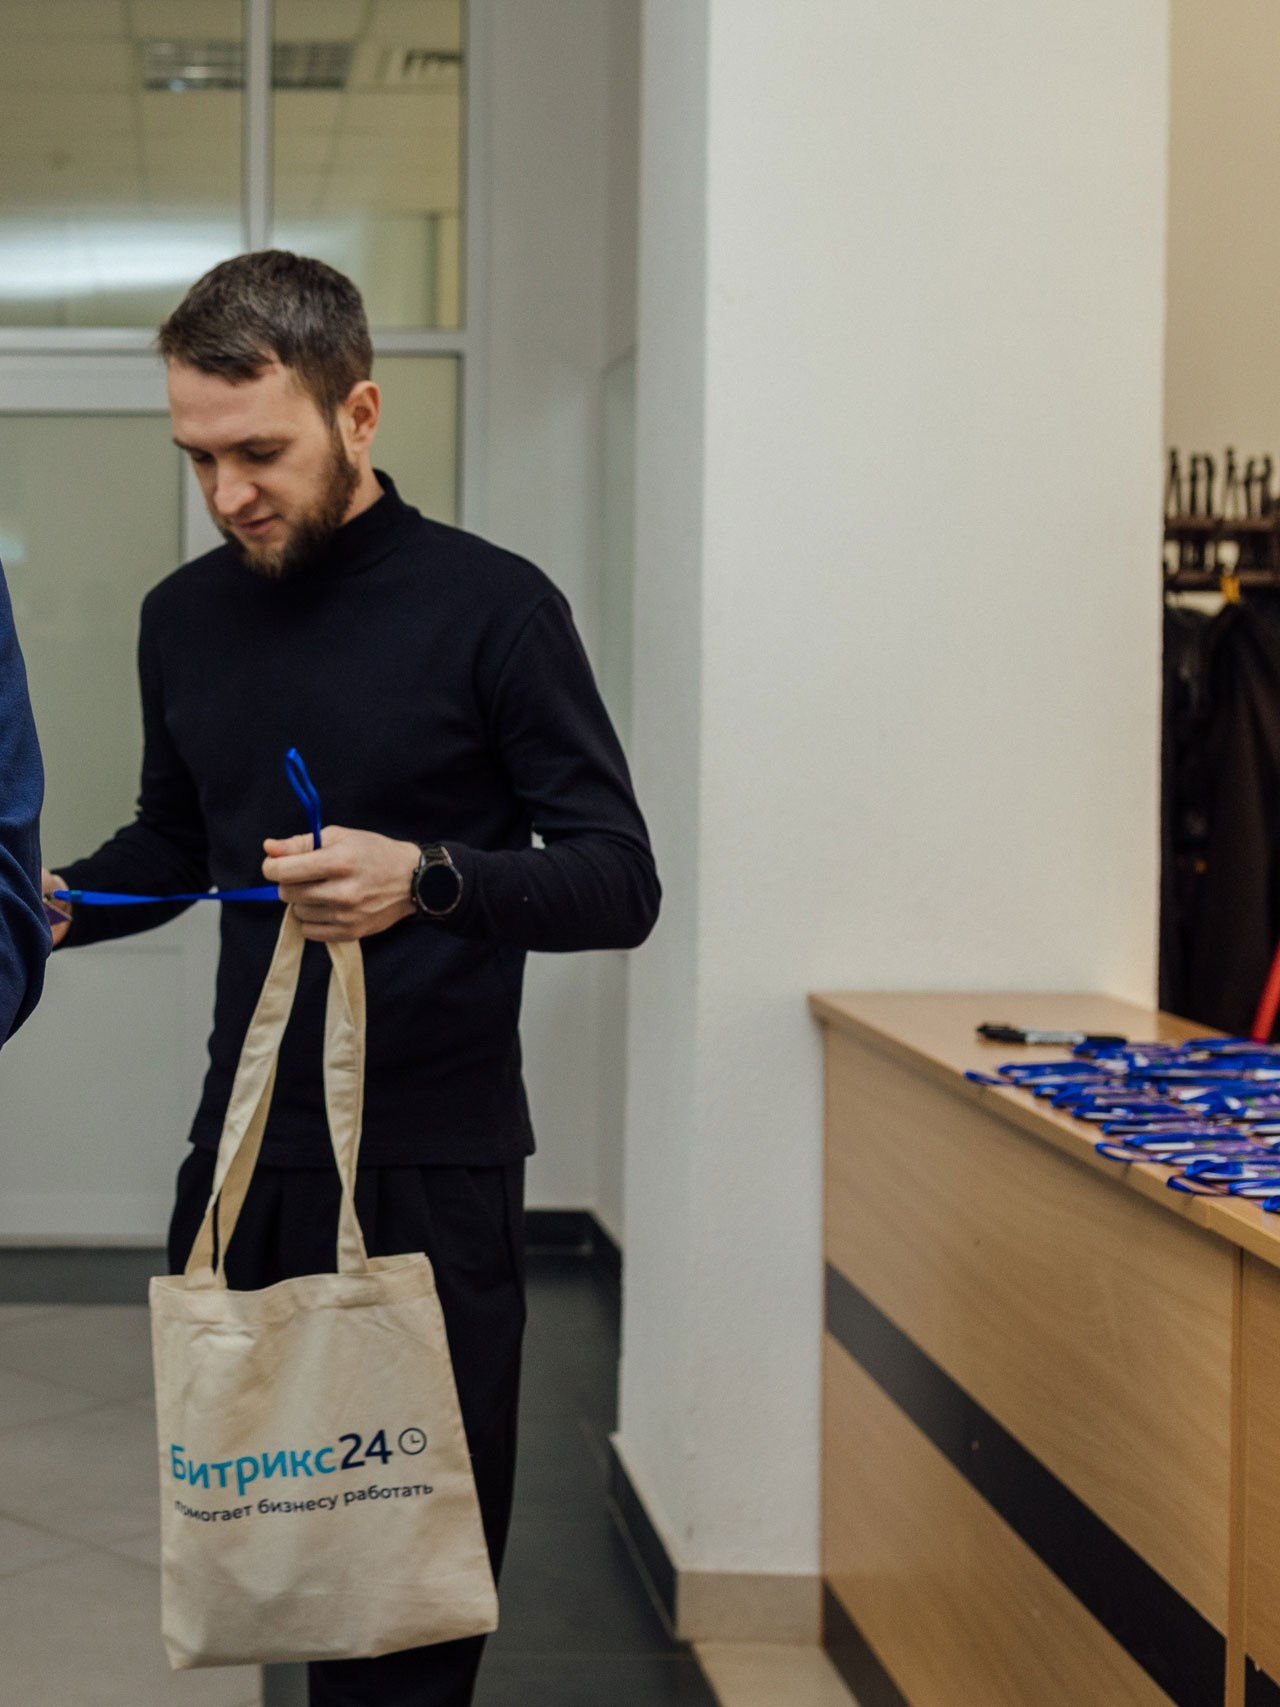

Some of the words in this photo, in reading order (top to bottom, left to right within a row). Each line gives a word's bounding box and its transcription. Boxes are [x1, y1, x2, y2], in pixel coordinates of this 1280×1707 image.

[170, 1428, 393, 1497] Битрикс24
[257, 1494, 339, 1516] бизнесу
[343, 1482, 434, 1505] работать
